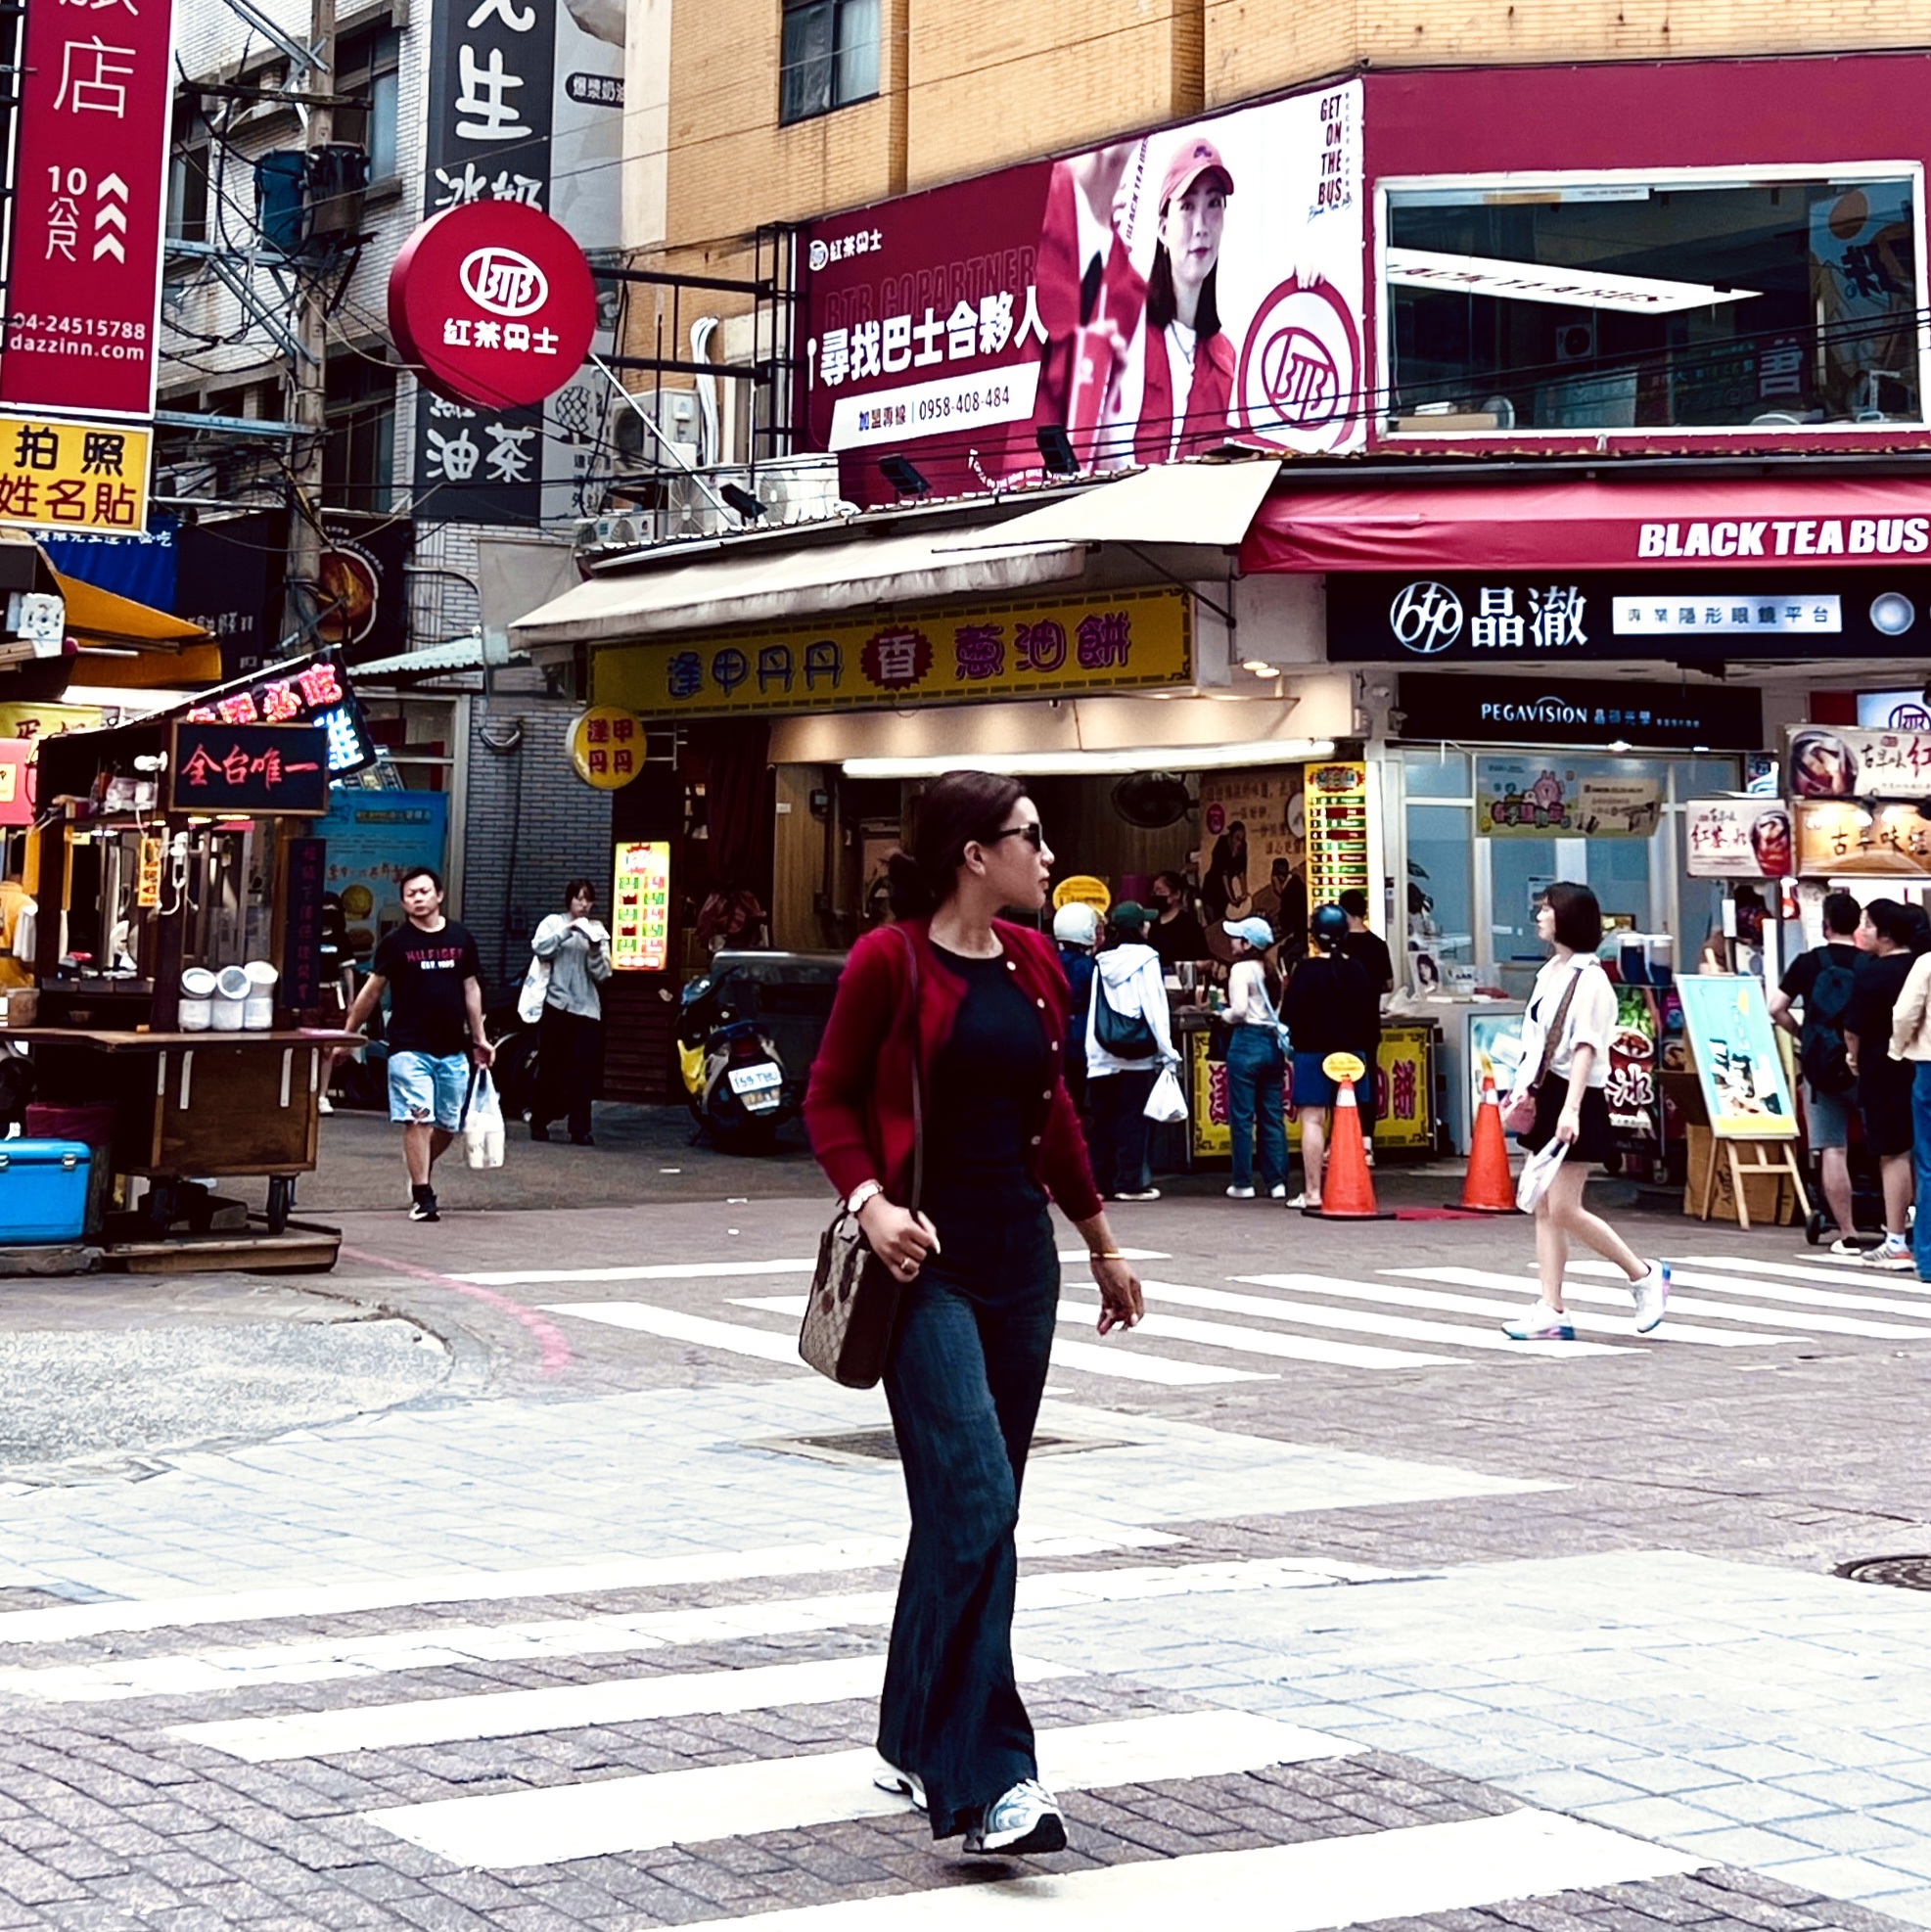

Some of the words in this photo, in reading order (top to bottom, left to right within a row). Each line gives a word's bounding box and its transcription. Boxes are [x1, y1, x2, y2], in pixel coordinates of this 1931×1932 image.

[1320, 94, 1342, 121] GET
[1326, 120, 1342, 147] ON
[1321, 149, 1342, 176] THE
[46, 164, 87, 196] 10
[1317, 177, 1342, 206] BUS
[45, 197, 79, 262] 公尺
[11, 311, 147, 342] 04-24515788
[820, 285, 1049, 387] 尋找巴士合夥人
[9, 333, 145, 362] dazzinn.com
[919, 386, 1010, 421] 0958-408-484
[14, 425, 126, 476] 拍照
[0, 478, 137, 527] 姓名貼
[1638, 522, 1768, 558] BLACK
[1771, 520, 1844, 555] TEA
[1849, 518, 1930, 554] BUS
[1471, 586, 1588, 648] 晶澈
[1481, 703, 1587, 724] PEGAVISION
[181, 744, 319, 791] 全台唯一
